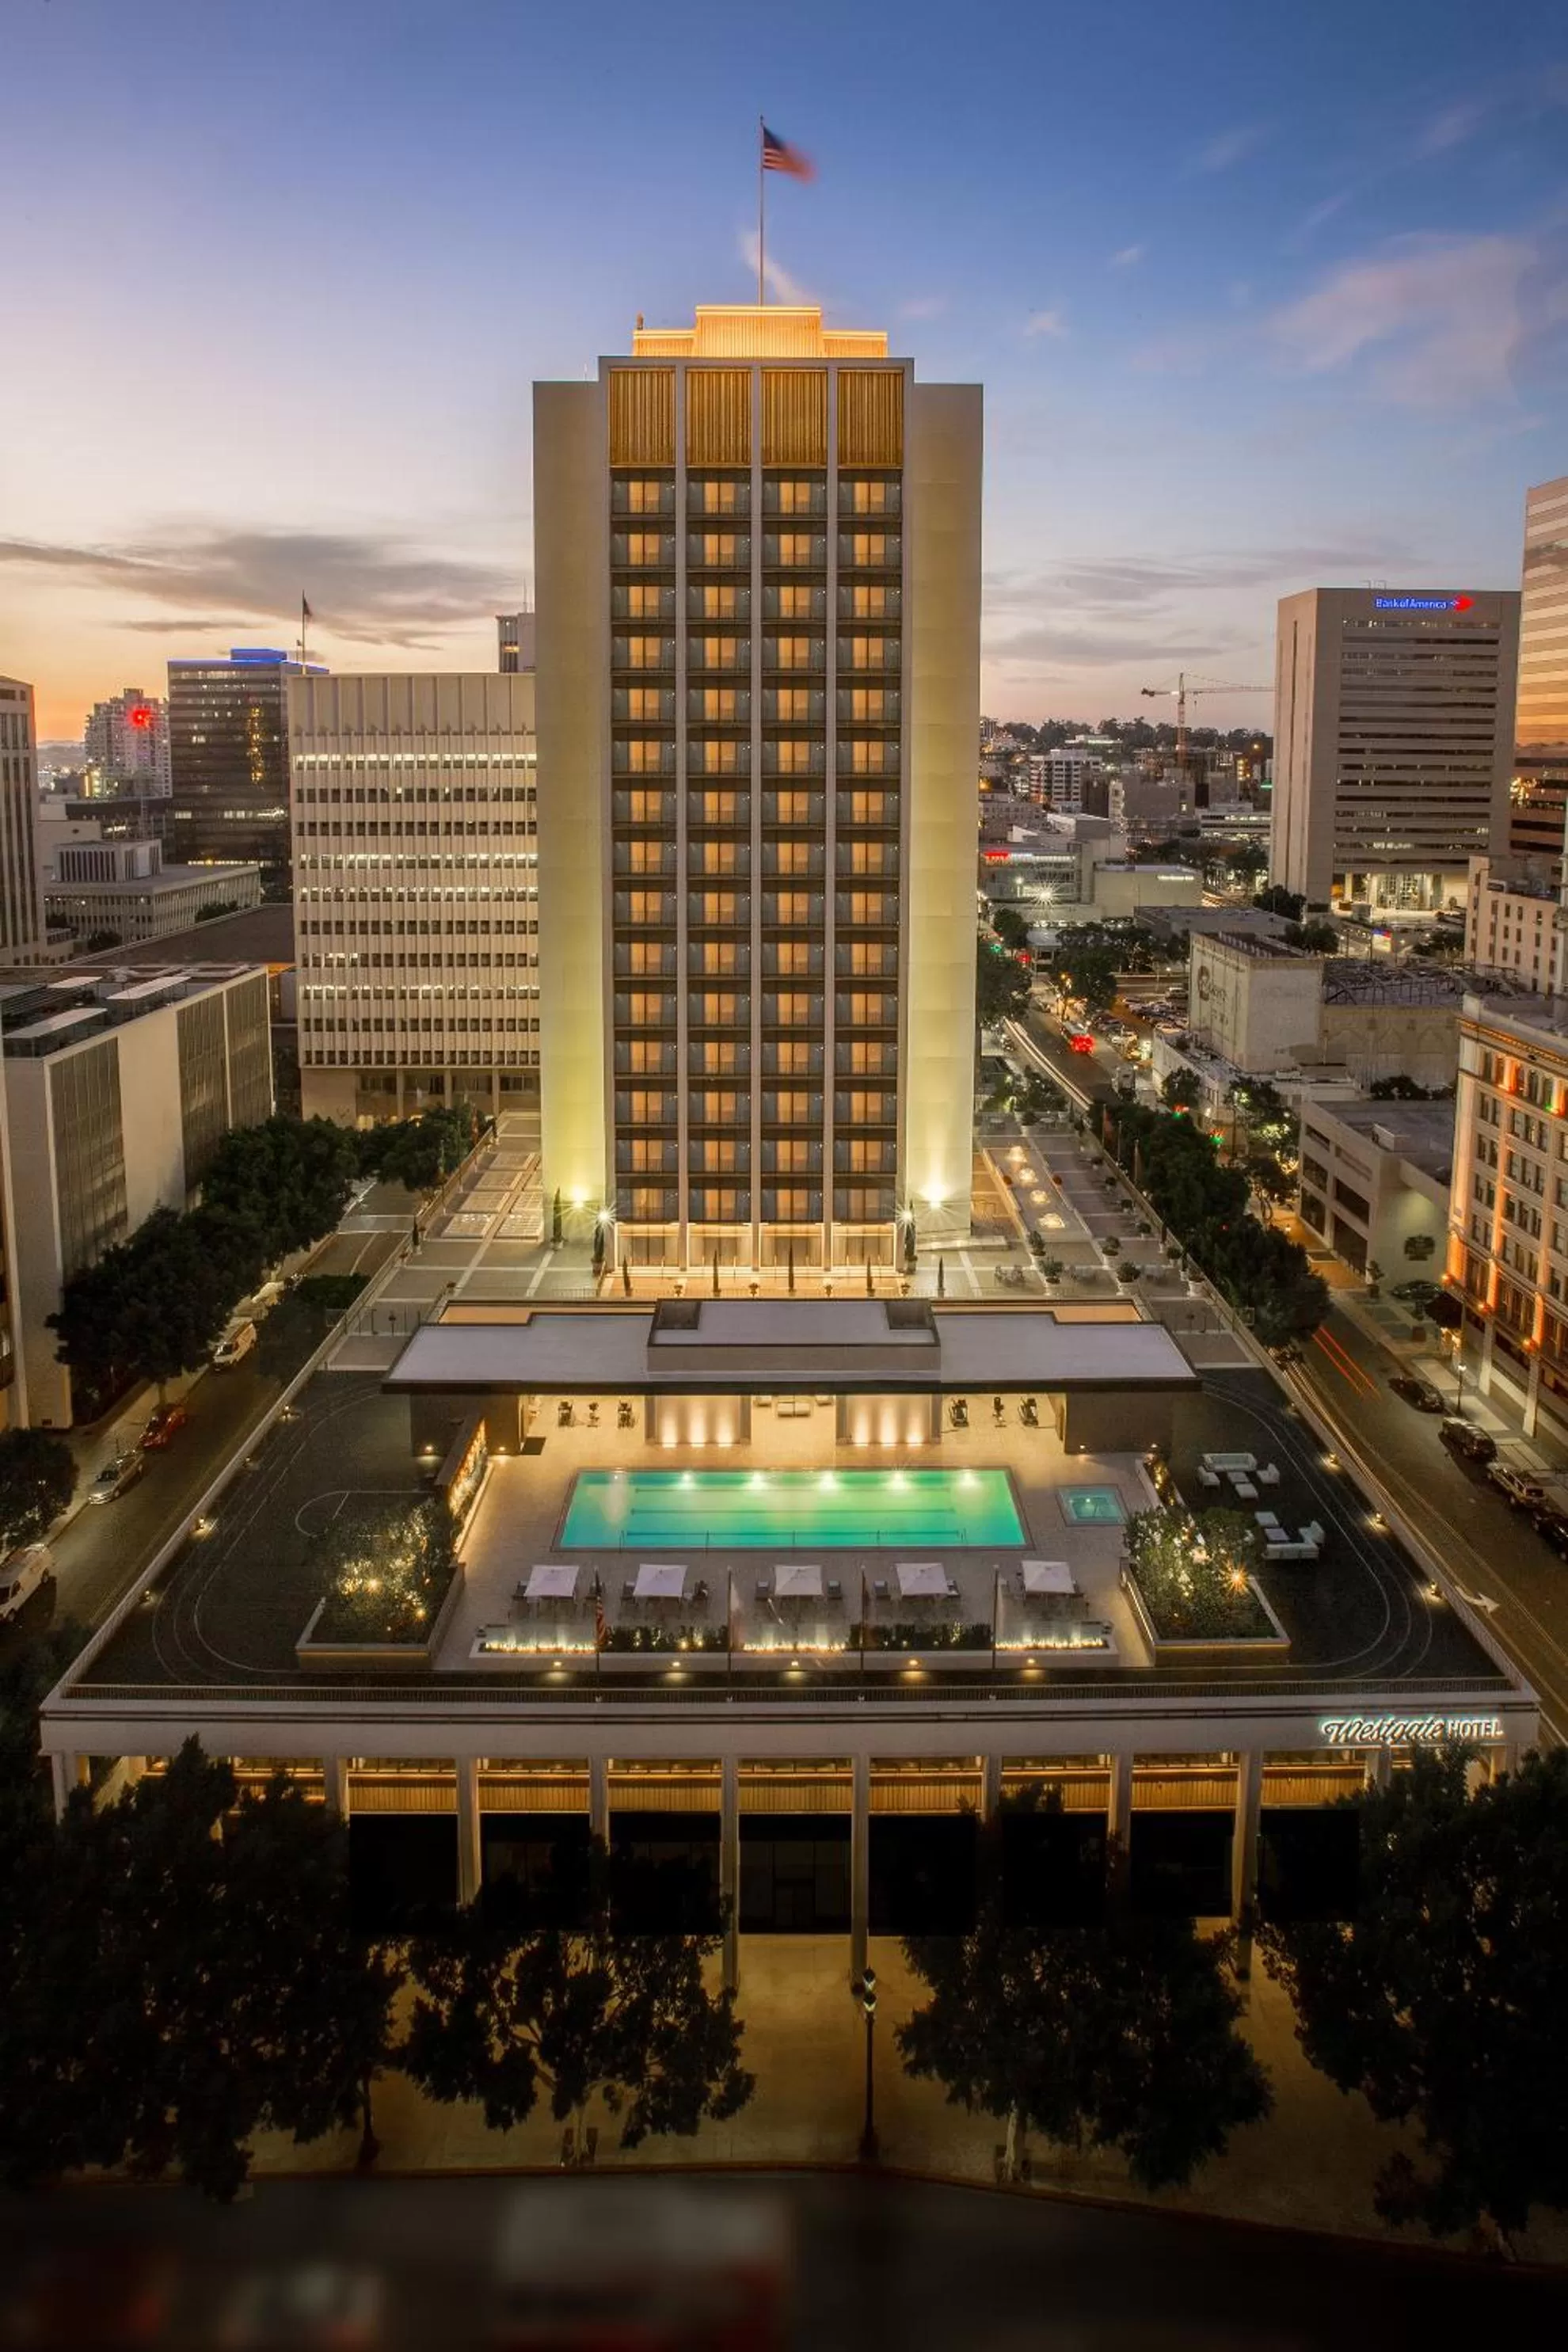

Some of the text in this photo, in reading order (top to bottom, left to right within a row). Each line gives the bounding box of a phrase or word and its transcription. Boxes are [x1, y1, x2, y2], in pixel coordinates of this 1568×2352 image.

[1376, 598, 1446, 609] Bank of America
[1321, 1716, 1504, 1745] Westgate HOTEL
